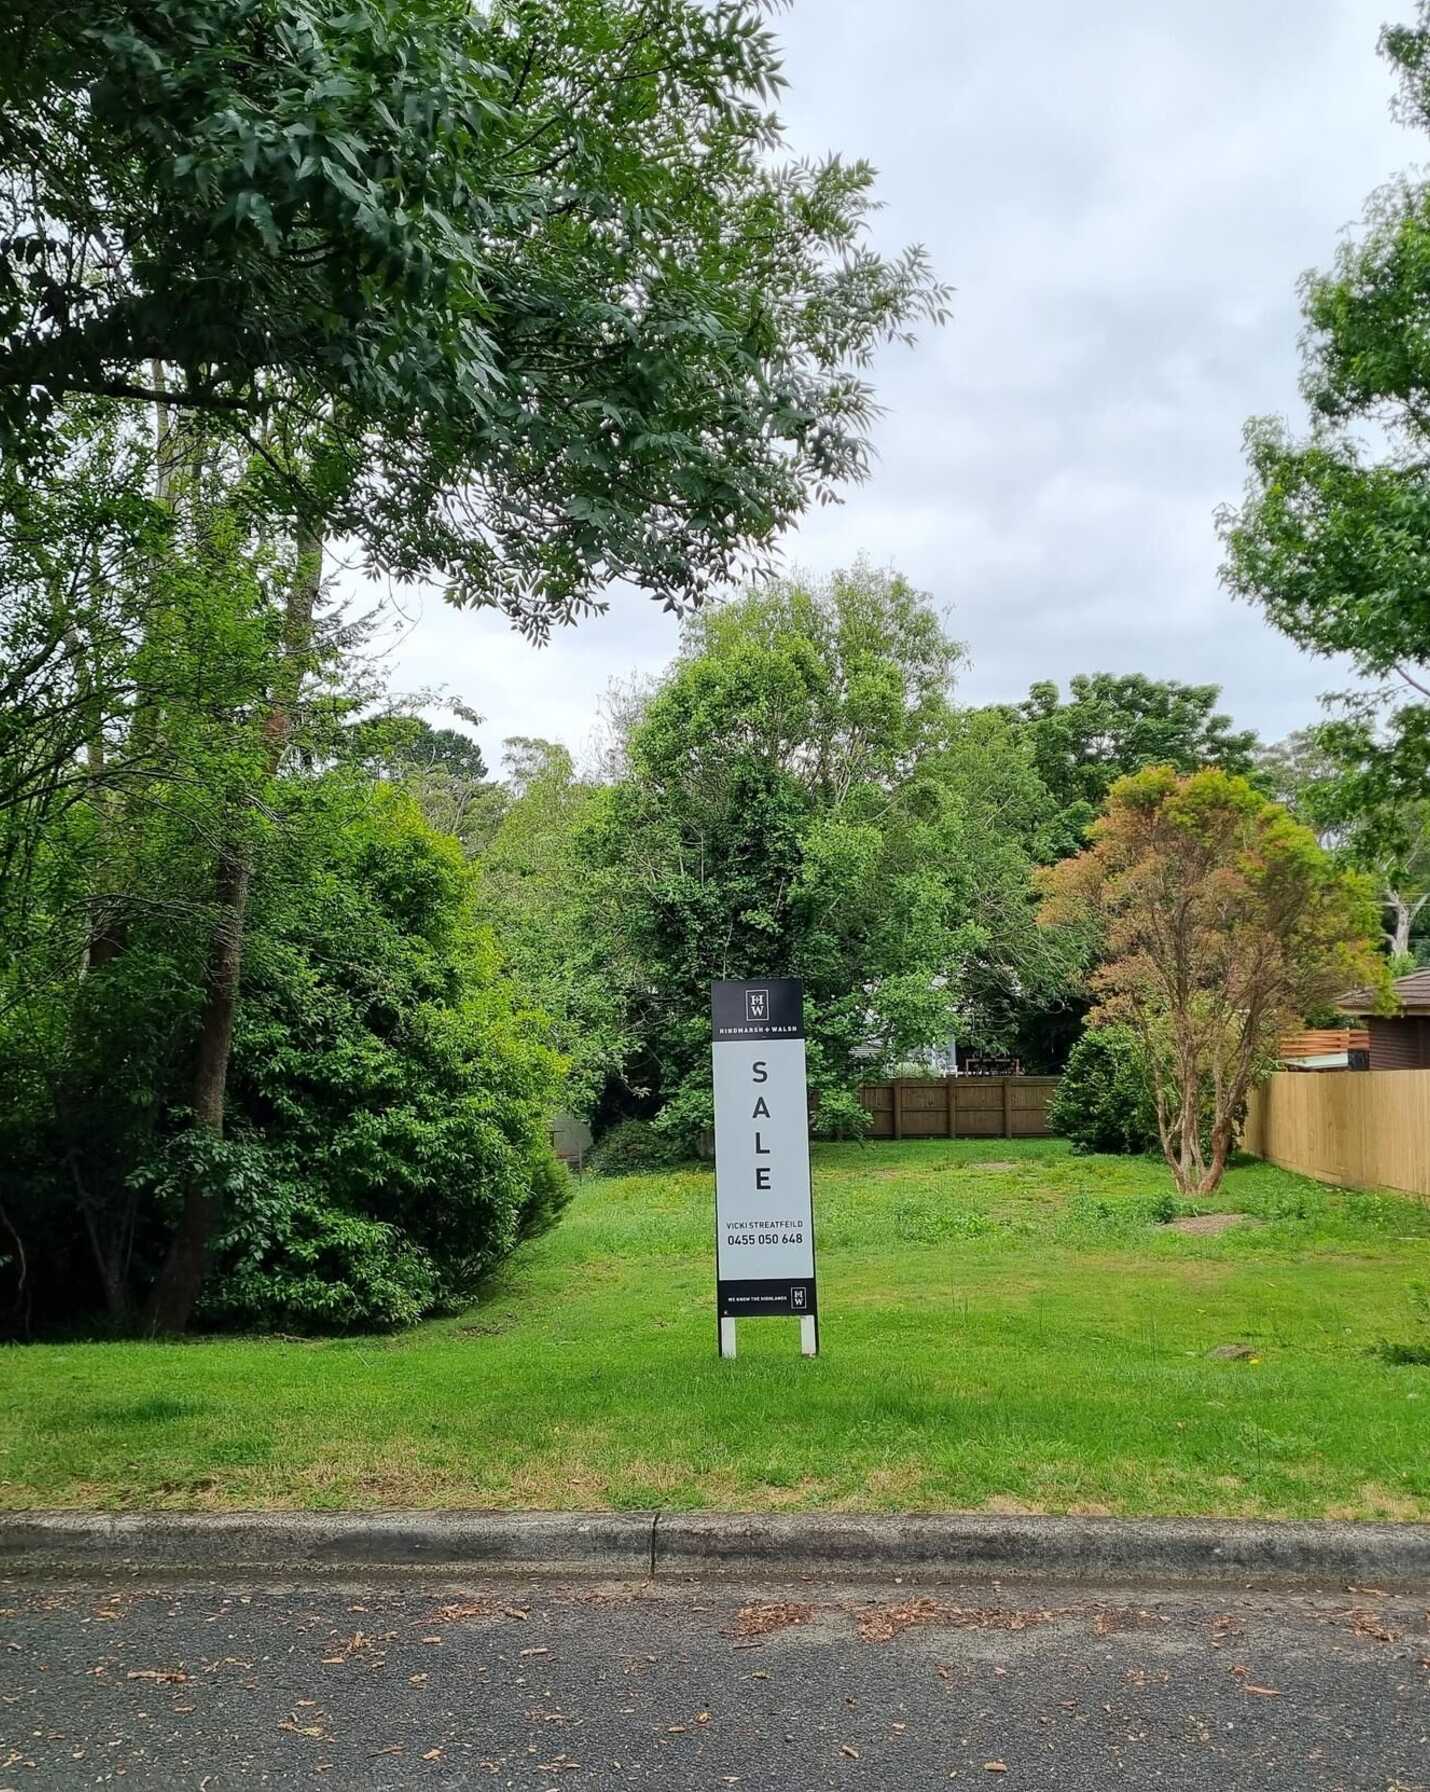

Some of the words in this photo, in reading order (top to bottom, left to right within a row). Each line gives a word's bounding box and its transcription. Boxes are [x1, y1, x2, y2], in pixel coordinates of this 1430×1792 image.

[752, 1061, 771, 1190] SALE
[727, 1235, 755, 1245] 0455
[758, 1234, 779, 1244] 050
[781, 1233, 803, 1244] 648
